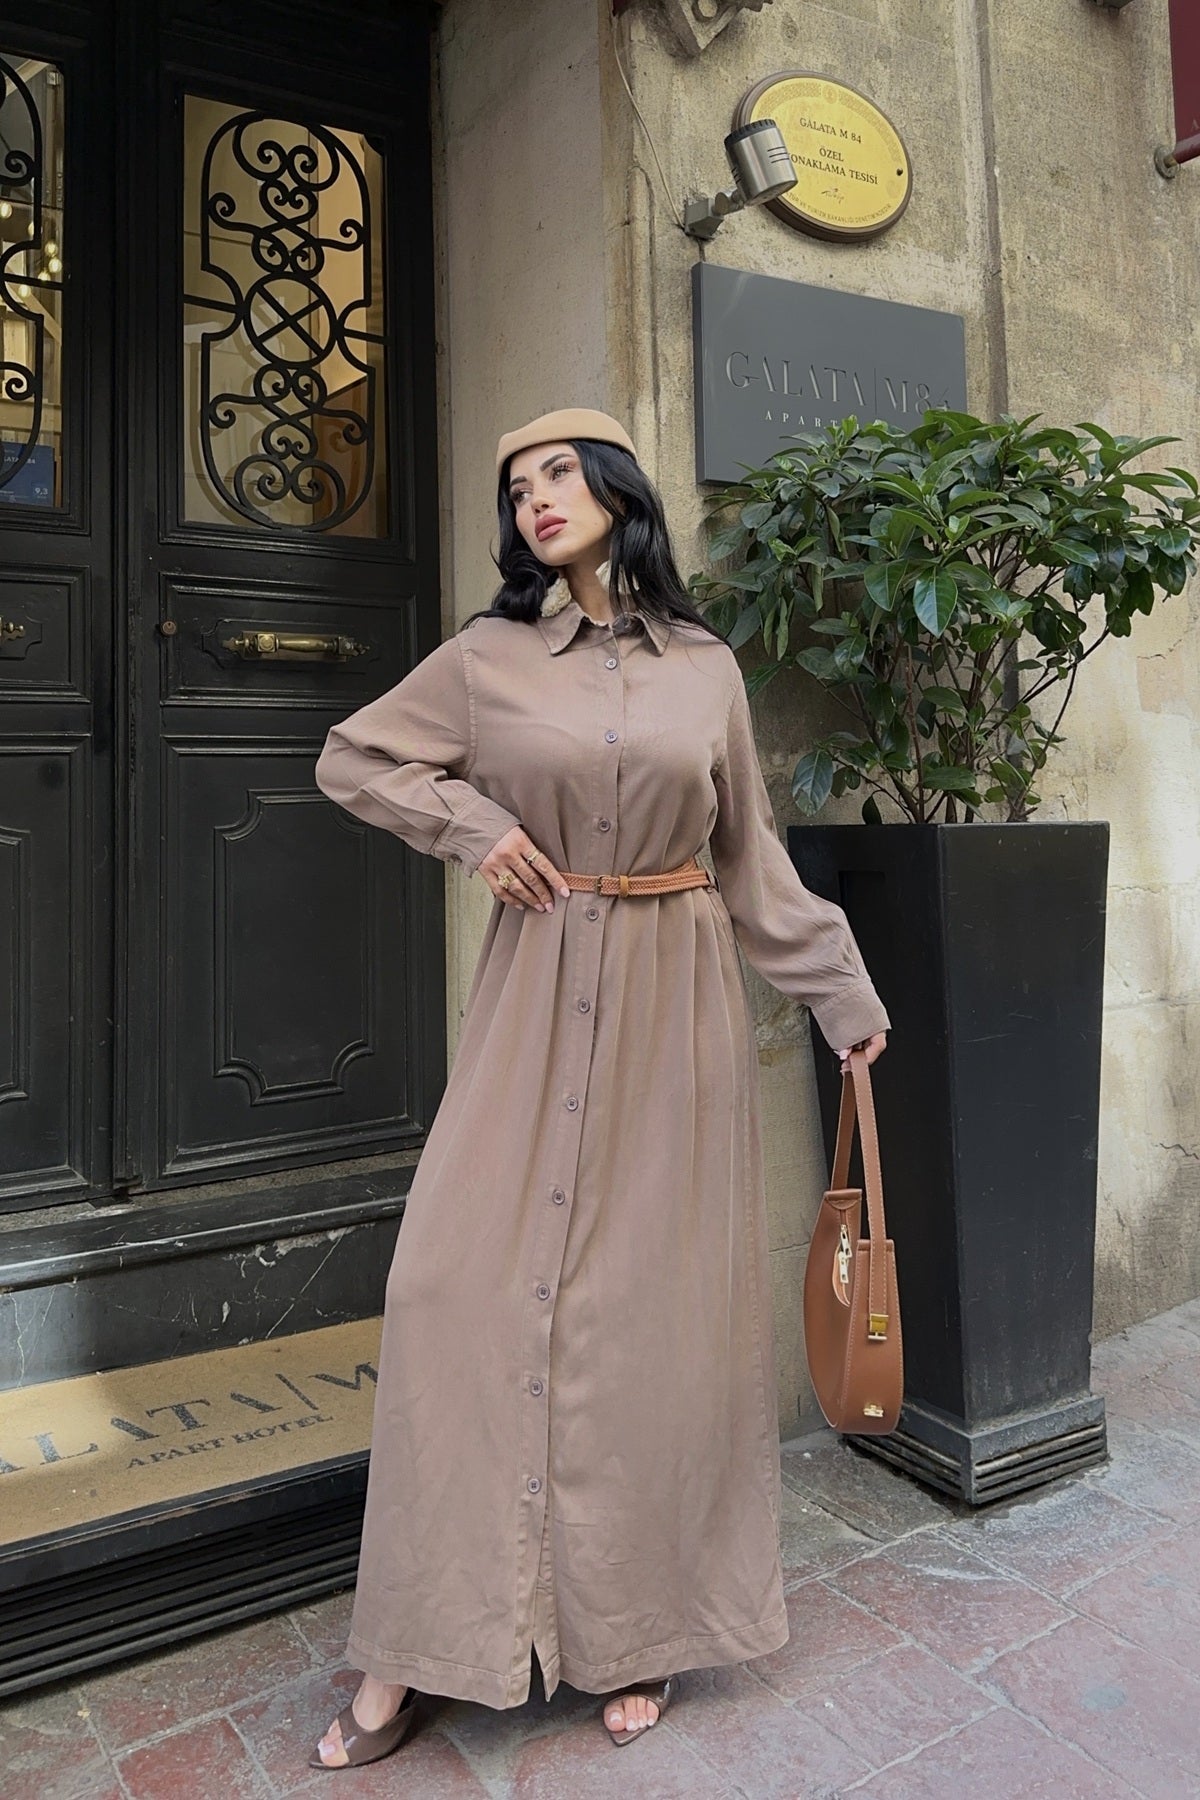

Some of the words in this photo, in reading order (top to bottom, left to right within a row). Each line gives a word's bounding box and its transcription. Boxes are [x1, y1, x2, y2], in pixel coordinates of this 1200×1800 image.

[840, 129, 848, 139] M
[851, 133, 862, 144] 84
[789, 154, 846, 176] ONAKLAMA
[819, 146, 844, 162] ÖZEL
[726, 351, 866, 406] GALATA
[126, 1437, 225, 1469] APART
[231, 1413, 333, 1444] HOTEL
